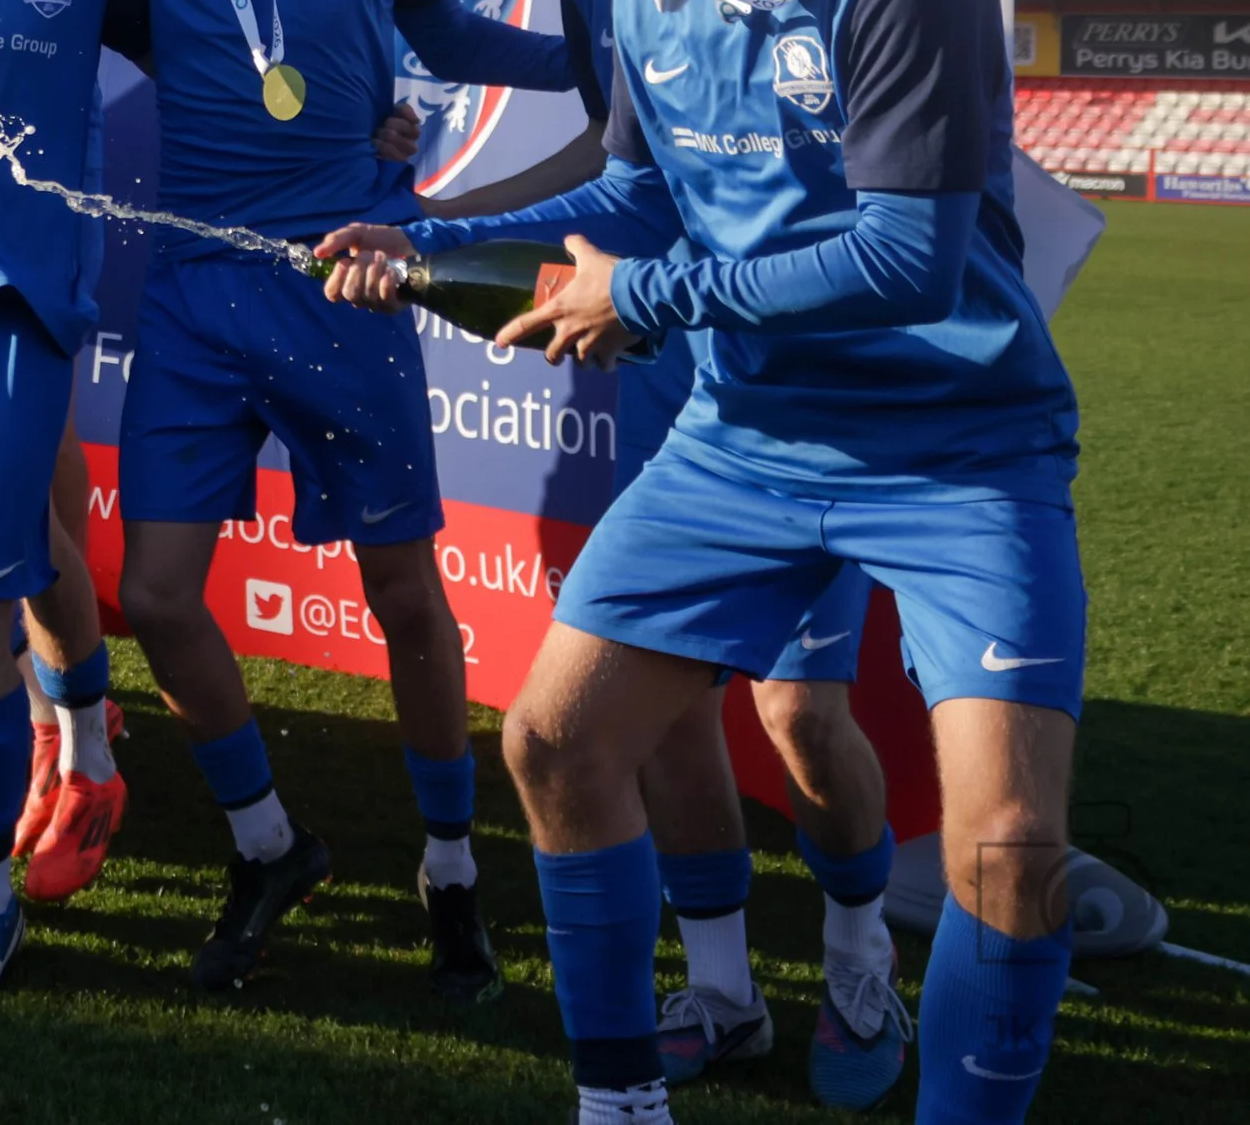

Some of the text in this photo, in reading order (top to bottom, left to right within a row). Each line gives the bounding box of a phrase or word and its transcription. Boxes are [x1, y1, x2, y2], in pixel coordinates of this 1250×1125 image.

[1082, 22, 1182, 43] PERRYS
[10, 34, 58, 59] Group
[1075, 49, 1250, 73] Perrys Kia Bu
[722, 132, 784, 159] Colleg
[427, 380, 616, 461] ociation
